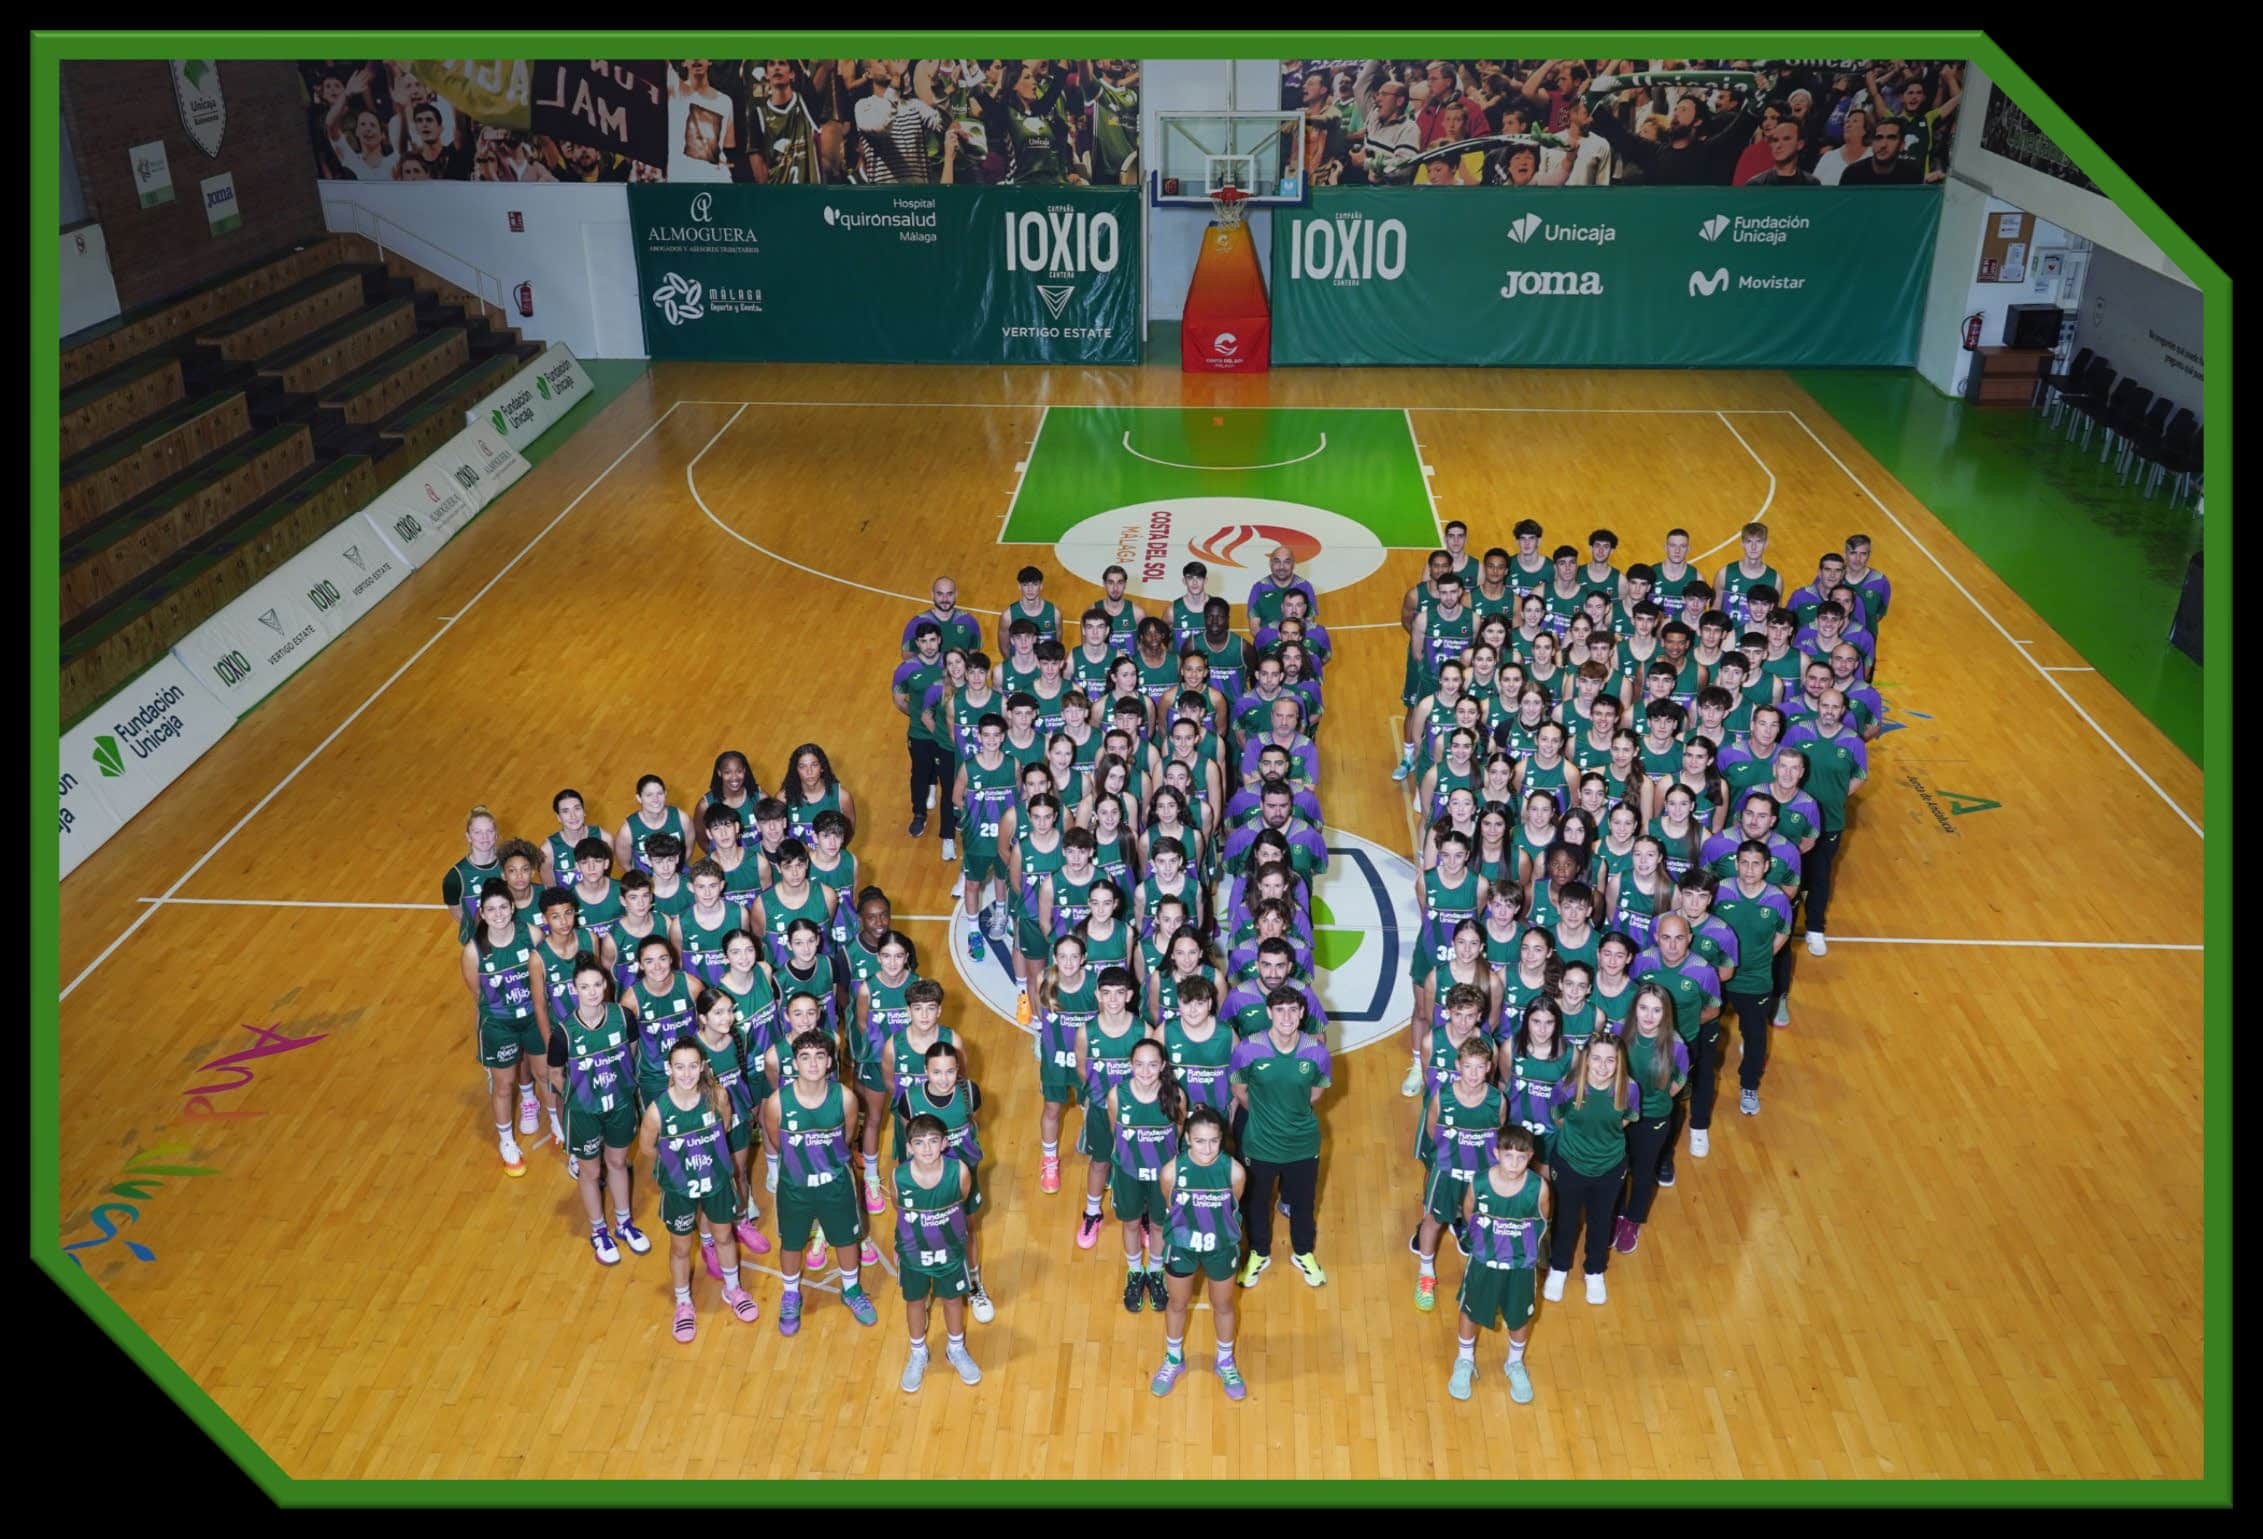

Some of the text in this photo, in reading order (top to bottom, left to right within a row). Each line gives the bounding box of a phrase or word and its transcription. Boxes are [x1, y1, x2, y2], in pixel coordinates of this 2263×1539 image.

[893, 198, 935, 211] Hospital
[840, 211, 936, 230] quirónsalud
[1734, 215, 1809, 230] Fundación
[648, 227, 758, 242] ALMOGUERA
[899, 231, 937, 243] Málaga
[1545, 224, 1616, 246] Unicaja
[1733, 230, 1787, 246] Unicaja
[1739, 276, 1805, 289] Movistar
[709, 287, 762, 300] MÁLAGA
[1002, 327, 1112, 338] VERTIGO ESTATE
[544, 360, 571, 381] Fundación
[501, 391, 533, 415] Fundación
[509, 408, 534, 429] Unicaja
[1142, 511, 1172, 582] COSTA DEL SOL
[268, 624, 316, 665] VERTIGO ESTATE
[113, 685, 184, 742] Fundación
[129, 715, 184, 759] Unicaja
[980, 823, 999, 838] 29
[505, 988, 531, 1004] Mijas
[594, 1051, 625, 1068] Unicaja
[1055, 1051, 1077, 1068] 46
[593, 1072, 618, 1089] Mijas
[1187, 1069, 1224, 1078] Fundación
[1187, 1074, 1214, 1084] Unicaja
[601, 1094, 614, 1113] 11
[687, 1130, 720, 1148] Unicaja
[805, 1131, 843, 1142] Fundación
[1137, 1127, 1173, 1137] Fundación
[1137, 1134, 1165, 1142] Unicaja
[805, 1137, 832, 1147] Unicaja
[1458, 1138, 1486, 1146] Unicaja
[685, 1154, 713, 1171] Mijas
[688, 1177, 712, 1198] 24
[1192, 1192, 1231, 1202] Fundación
[1192, 1199, 1222, 1208] Unicaja
[921, 1206, 960, 1220] Fundación
[921, 1217, 950, 1227] Unicaja
[1492, 1220, 1531, 1230] Fundación
[1492, 1226, 1522, 1237] Unicaja
[1190, 1231, 1216, 1252] 48
[920, 1249, 947, 1266] 54
